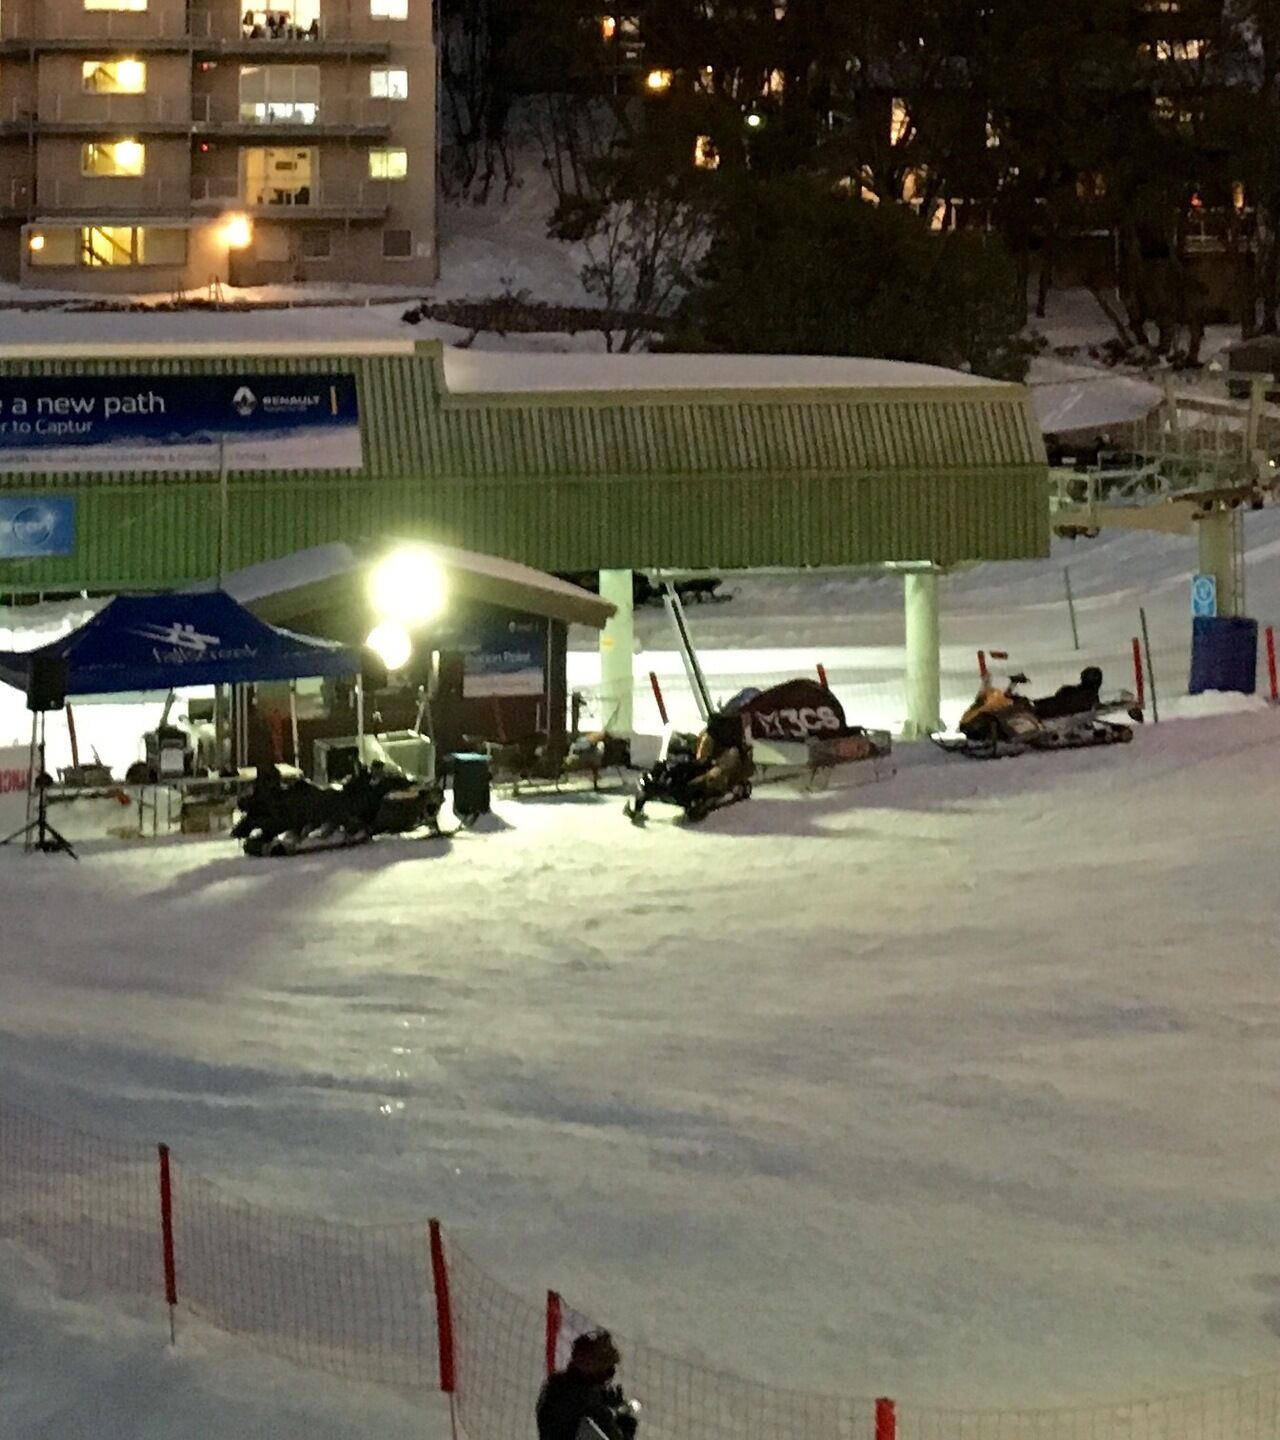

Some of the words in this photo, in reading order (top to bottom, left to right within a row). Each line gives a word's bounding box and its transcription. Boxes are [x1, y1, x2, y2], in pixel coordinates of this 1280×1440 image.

[11, 397, 28, 415] a
[36, 396, 96, 415] new
[103, 391, 166, 419] path
[12, 419, 31, 434] to
[35, 418, 94, 436] Captur
